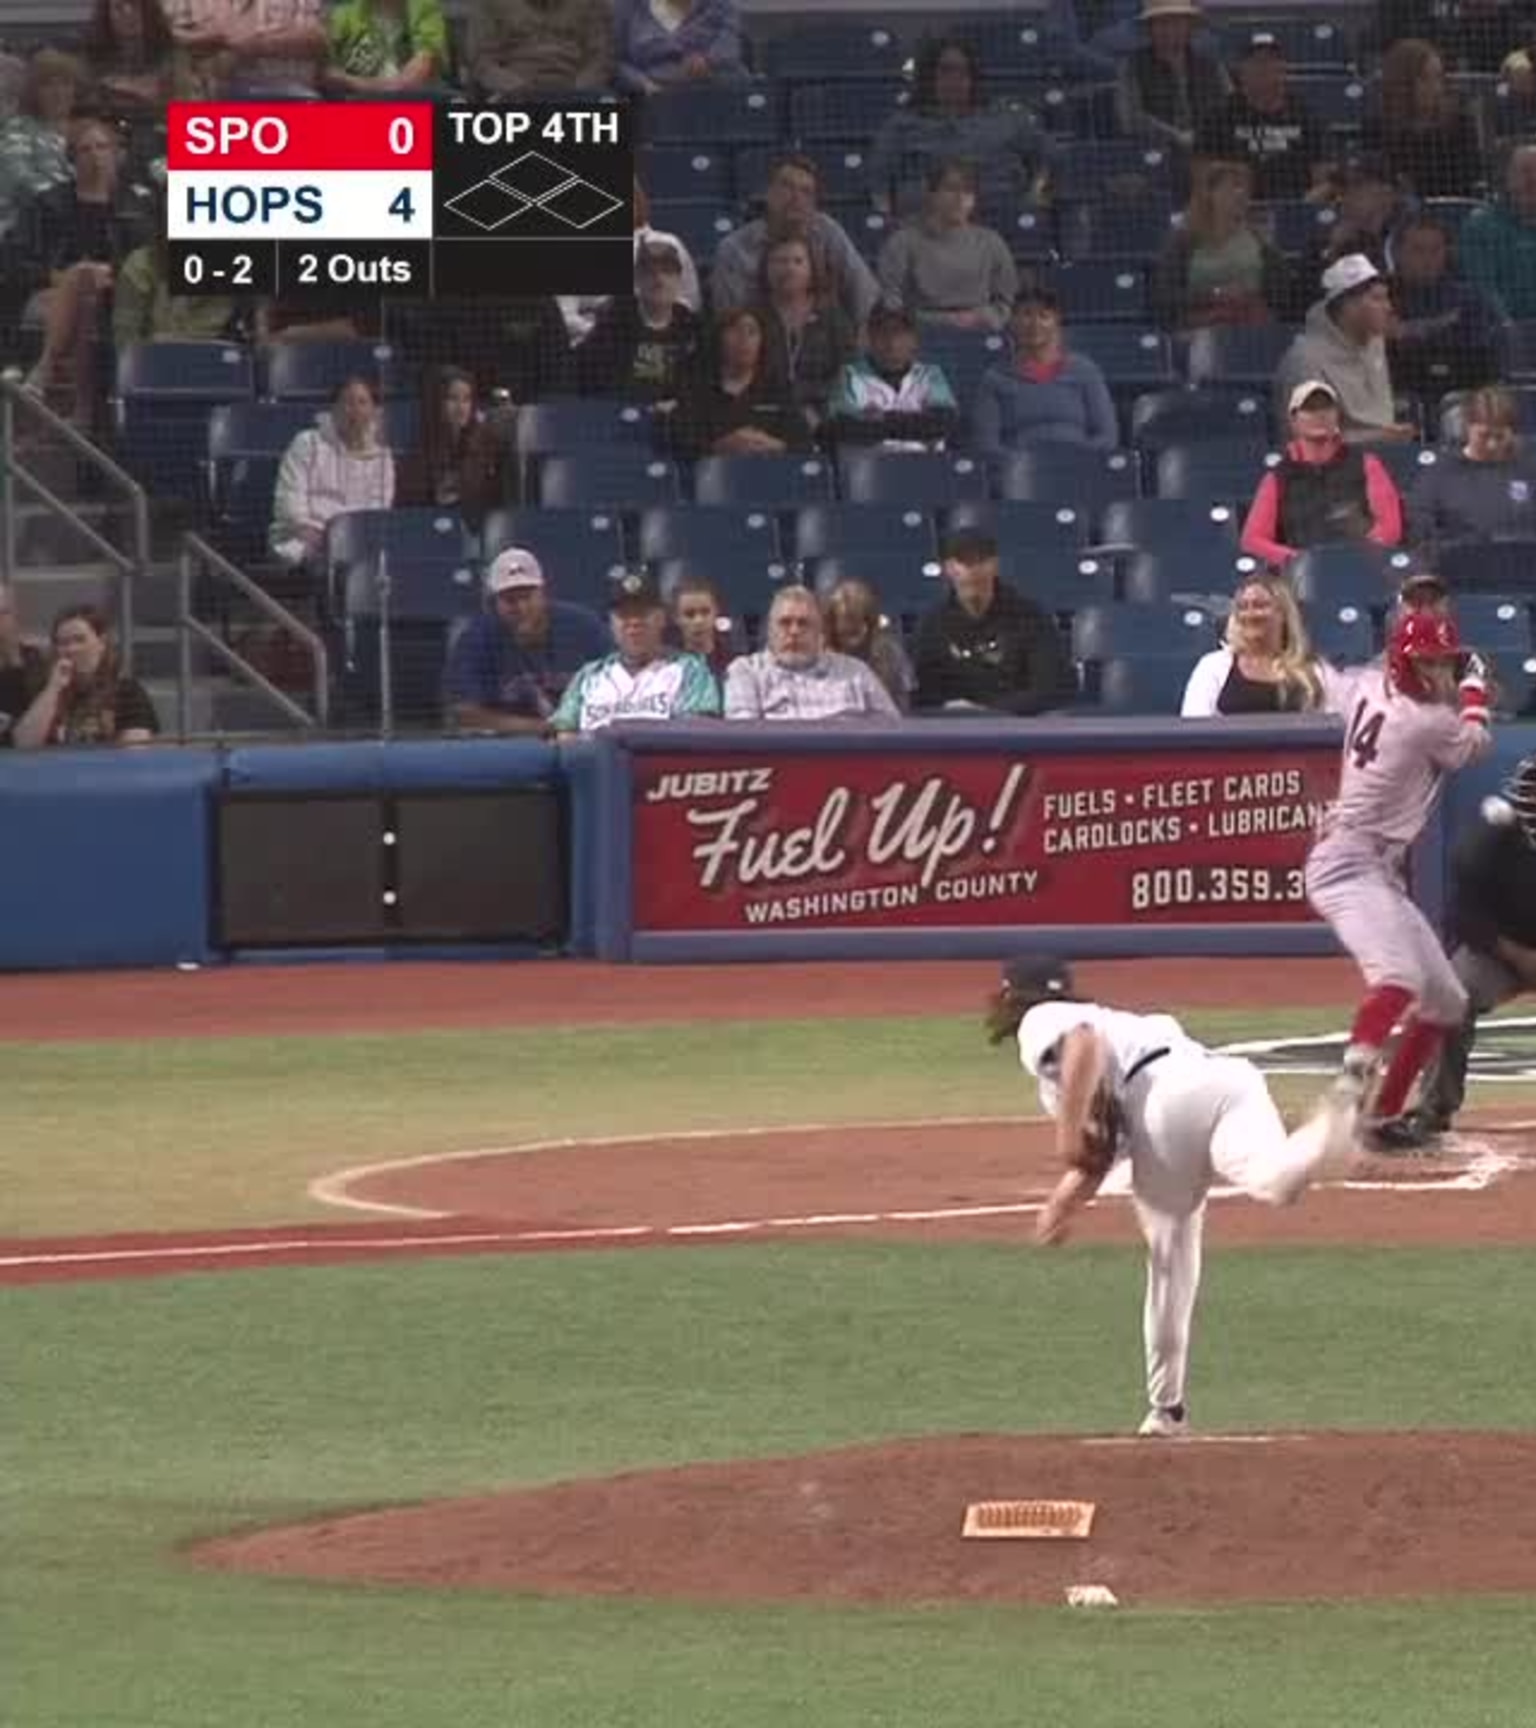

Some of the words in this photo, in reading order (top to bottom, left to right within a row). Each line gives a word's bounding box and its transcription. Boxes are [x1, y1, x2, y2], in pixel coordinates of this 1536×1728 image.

[1346, 697, 1386, 769] 14
[647, 767, 774, 801] JUBITZ
[1043, 788, 1117, 820] FUELS
[1143, 778, 1215, 810] FLEET
[1223, 769, 1302, 802] CARDS
[686, 786, 849, 887] Fuel
[867, 762, 1026, 888] Up!
[1043, 816, 1182, 854] CARDLOCKS
[745, 883, 919, 924] WASHINGTON
[935, 870, 1039, 901] COUNTY
